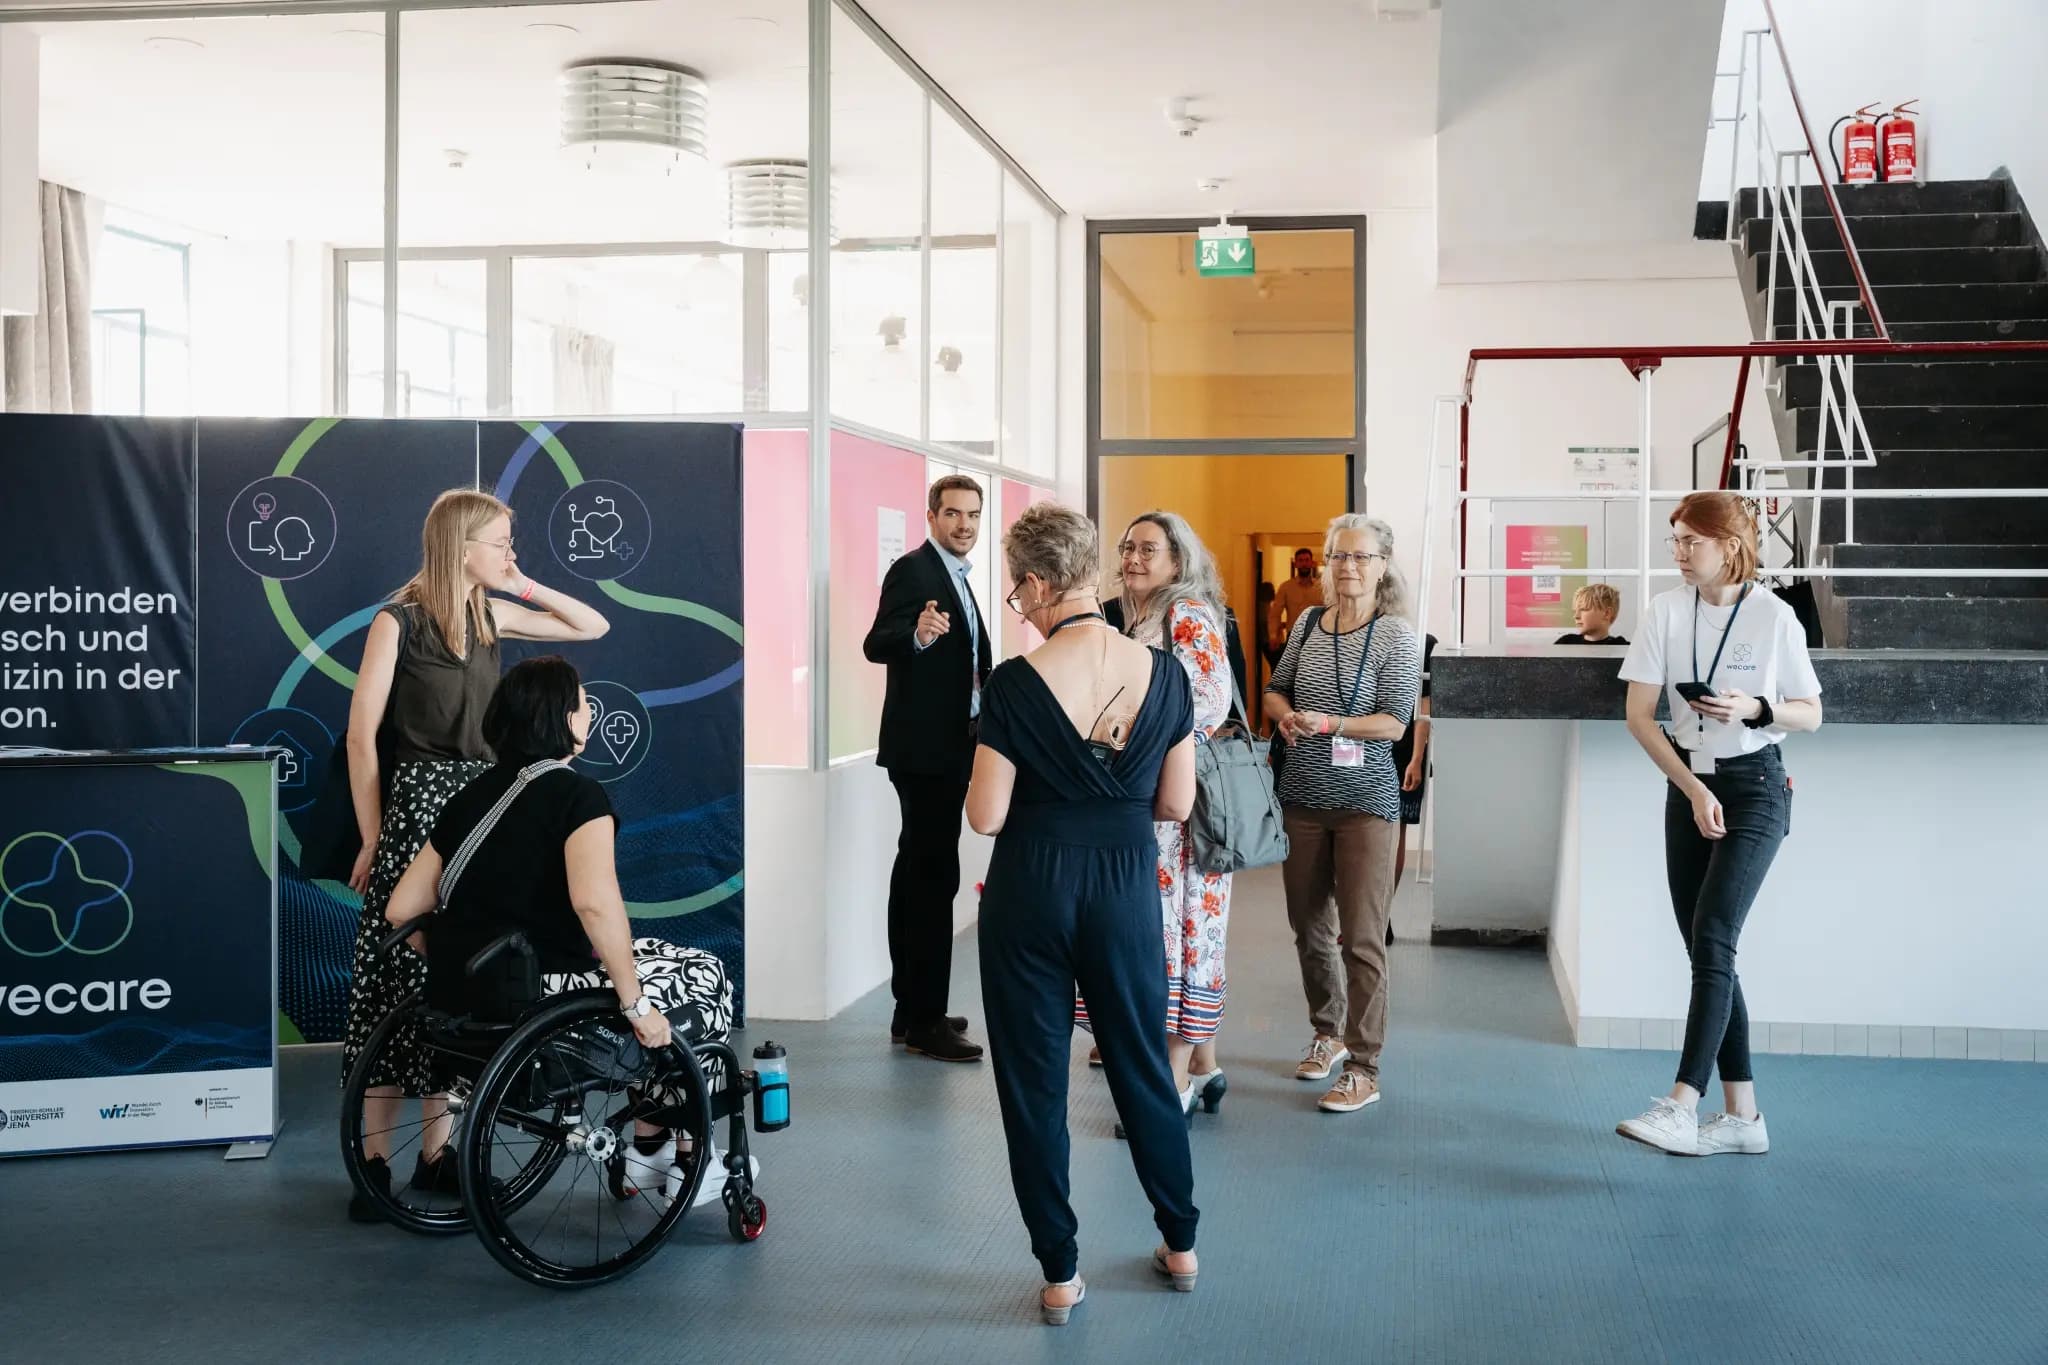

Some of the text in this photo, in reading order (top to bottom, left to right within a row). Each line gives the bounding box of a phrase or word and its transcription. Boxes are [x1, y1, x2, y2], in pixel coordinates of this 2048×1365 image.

[1, 624, 148, 651] sch und
[4, 662, 180, 690] izin in der
[0, 978, 172, 1016] ecare
[7, 1121, 31, 1129] JENA
[99, 1104, 130, 1119] wir!
